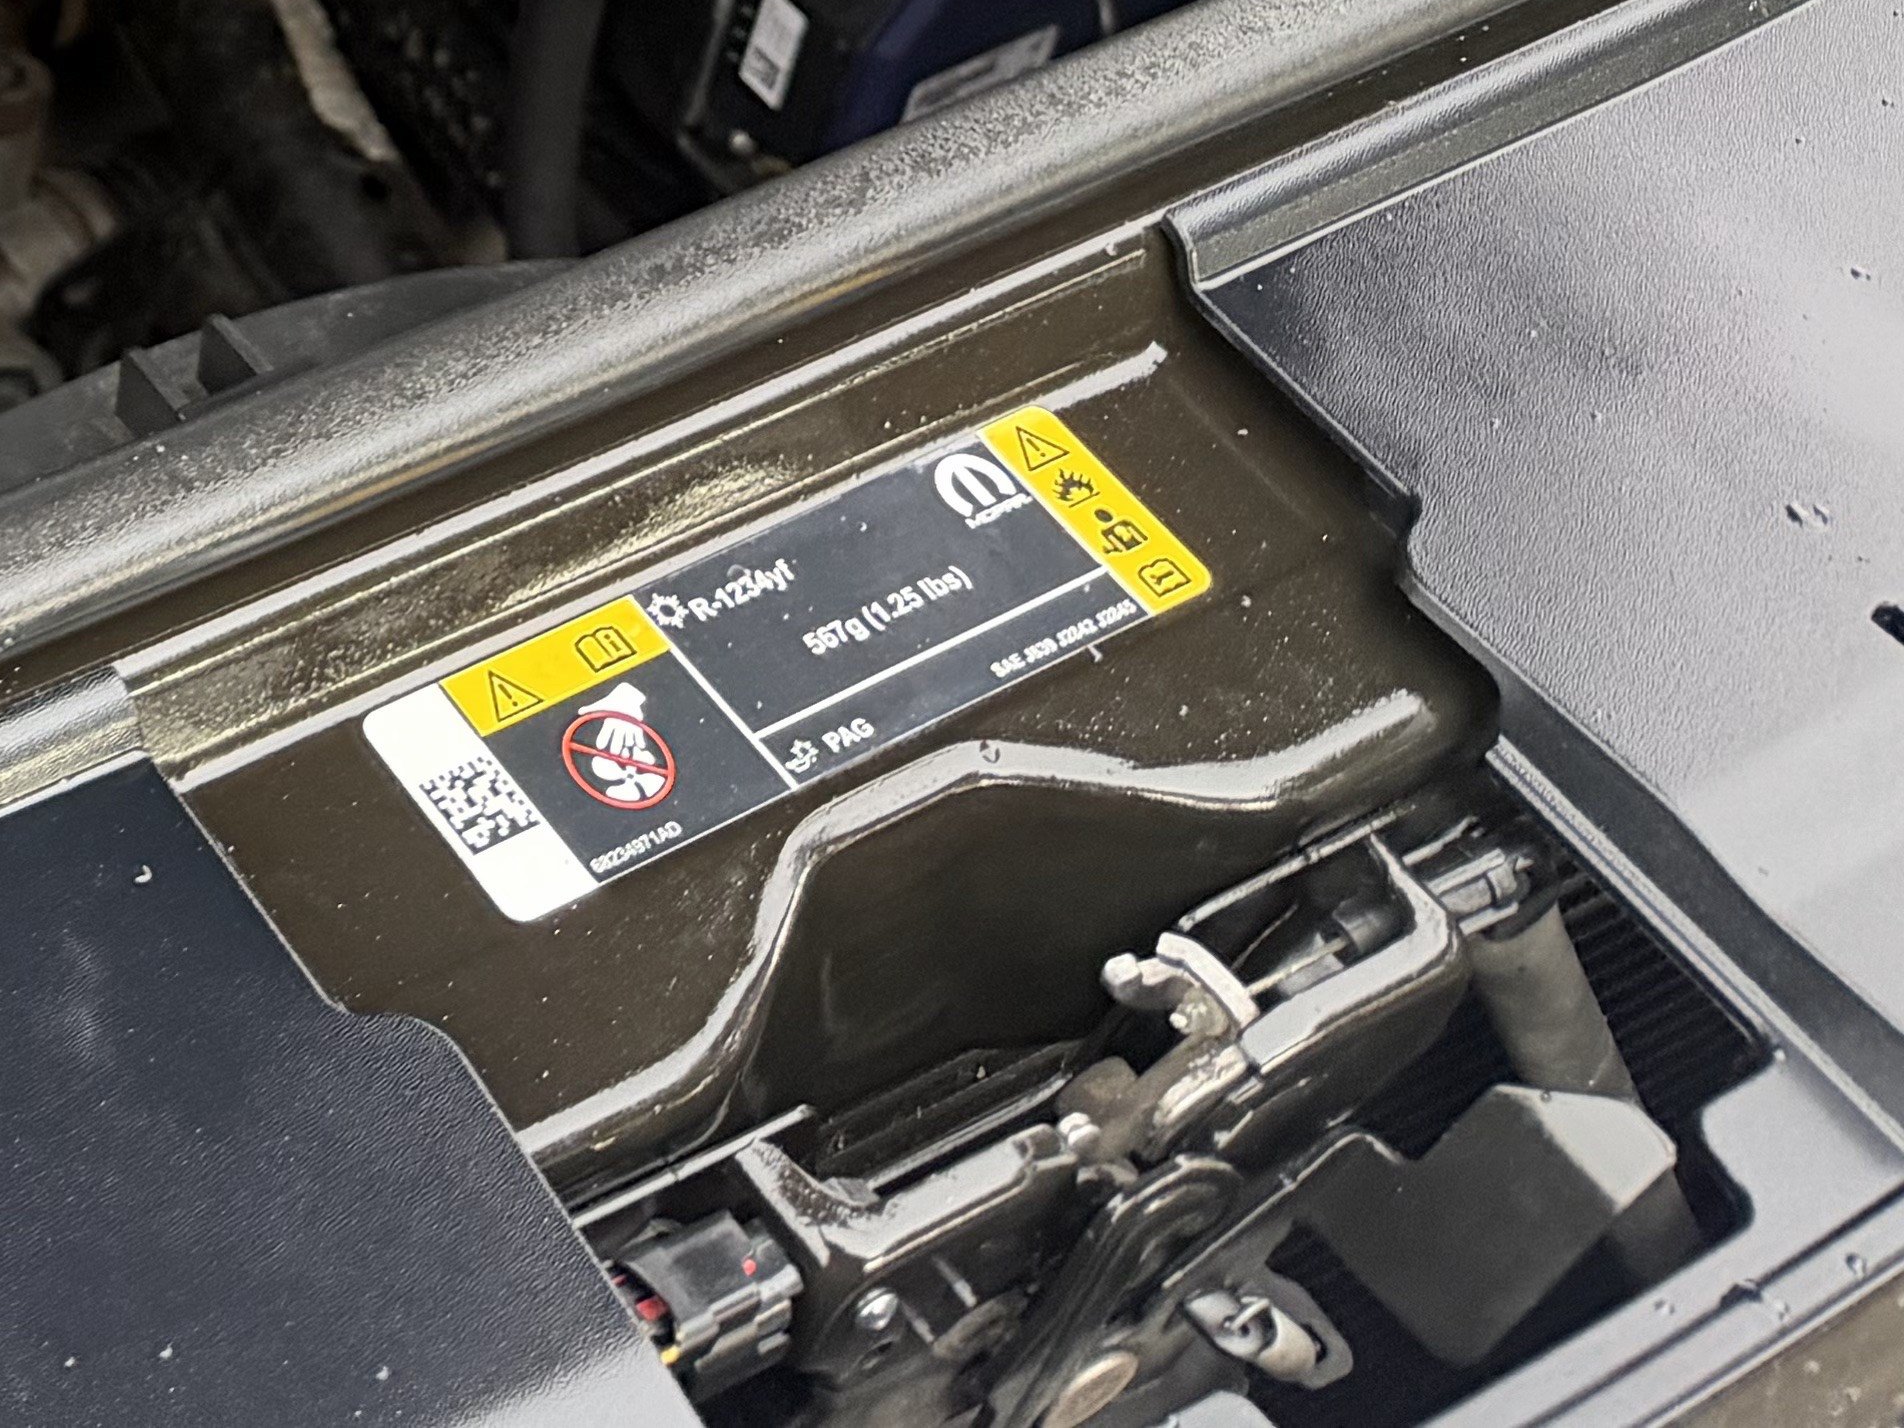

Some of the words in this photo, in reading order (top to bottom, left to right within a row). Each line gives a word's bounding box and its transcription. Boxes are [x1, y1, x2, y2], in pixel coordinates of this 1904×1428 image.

[688, 558, 796, 622] R-1234yf
[802, 619, 871, 656] 567g
[861, 586, 924, 632] (1.25
[917, 565, 974, 602] lbs)
[821, 717, 875, 754] PAG
